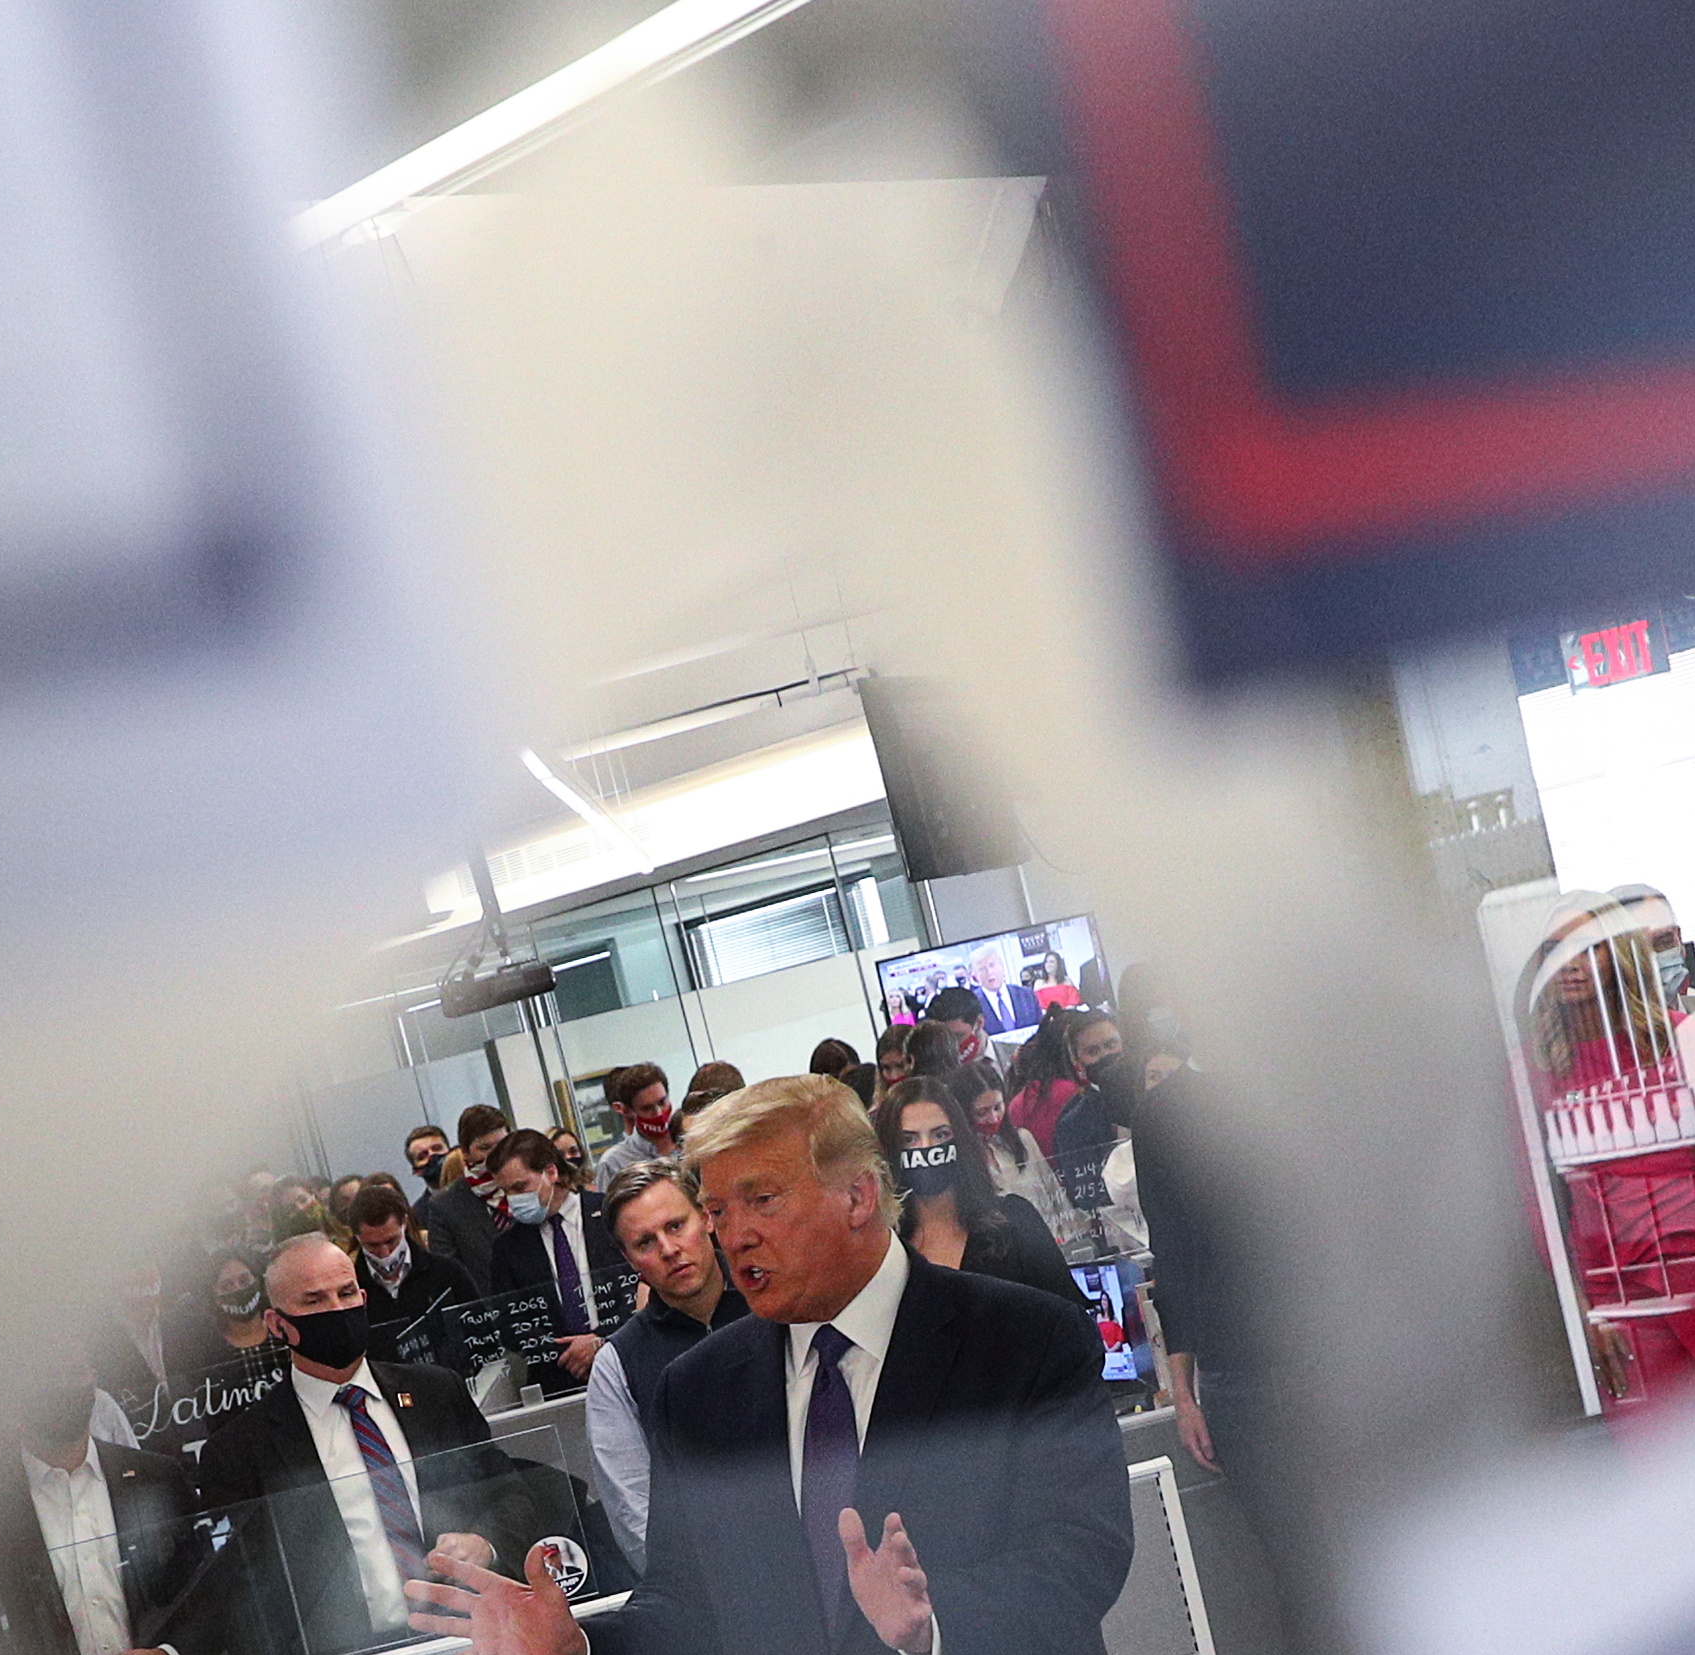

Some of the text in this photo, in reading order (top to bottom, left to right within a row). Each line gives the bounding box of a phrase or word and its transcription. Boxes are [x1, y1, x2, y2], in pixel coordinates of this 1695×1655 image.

[1579, 620, 1654, 687] EXIT
[573, 1281, 613, 1298] TUMP
[221, 1291, 261, 1314] TRUMP
[459, 1297, 548, 1325] TRUMP 2068
[578, 1299, 616, 1314] TUMP
[584, 1315, 620, 1328] TUMP
[464, 1316, 552, 1349] TRUMP 2072
[525, 1351, 558, 1366] 2080
